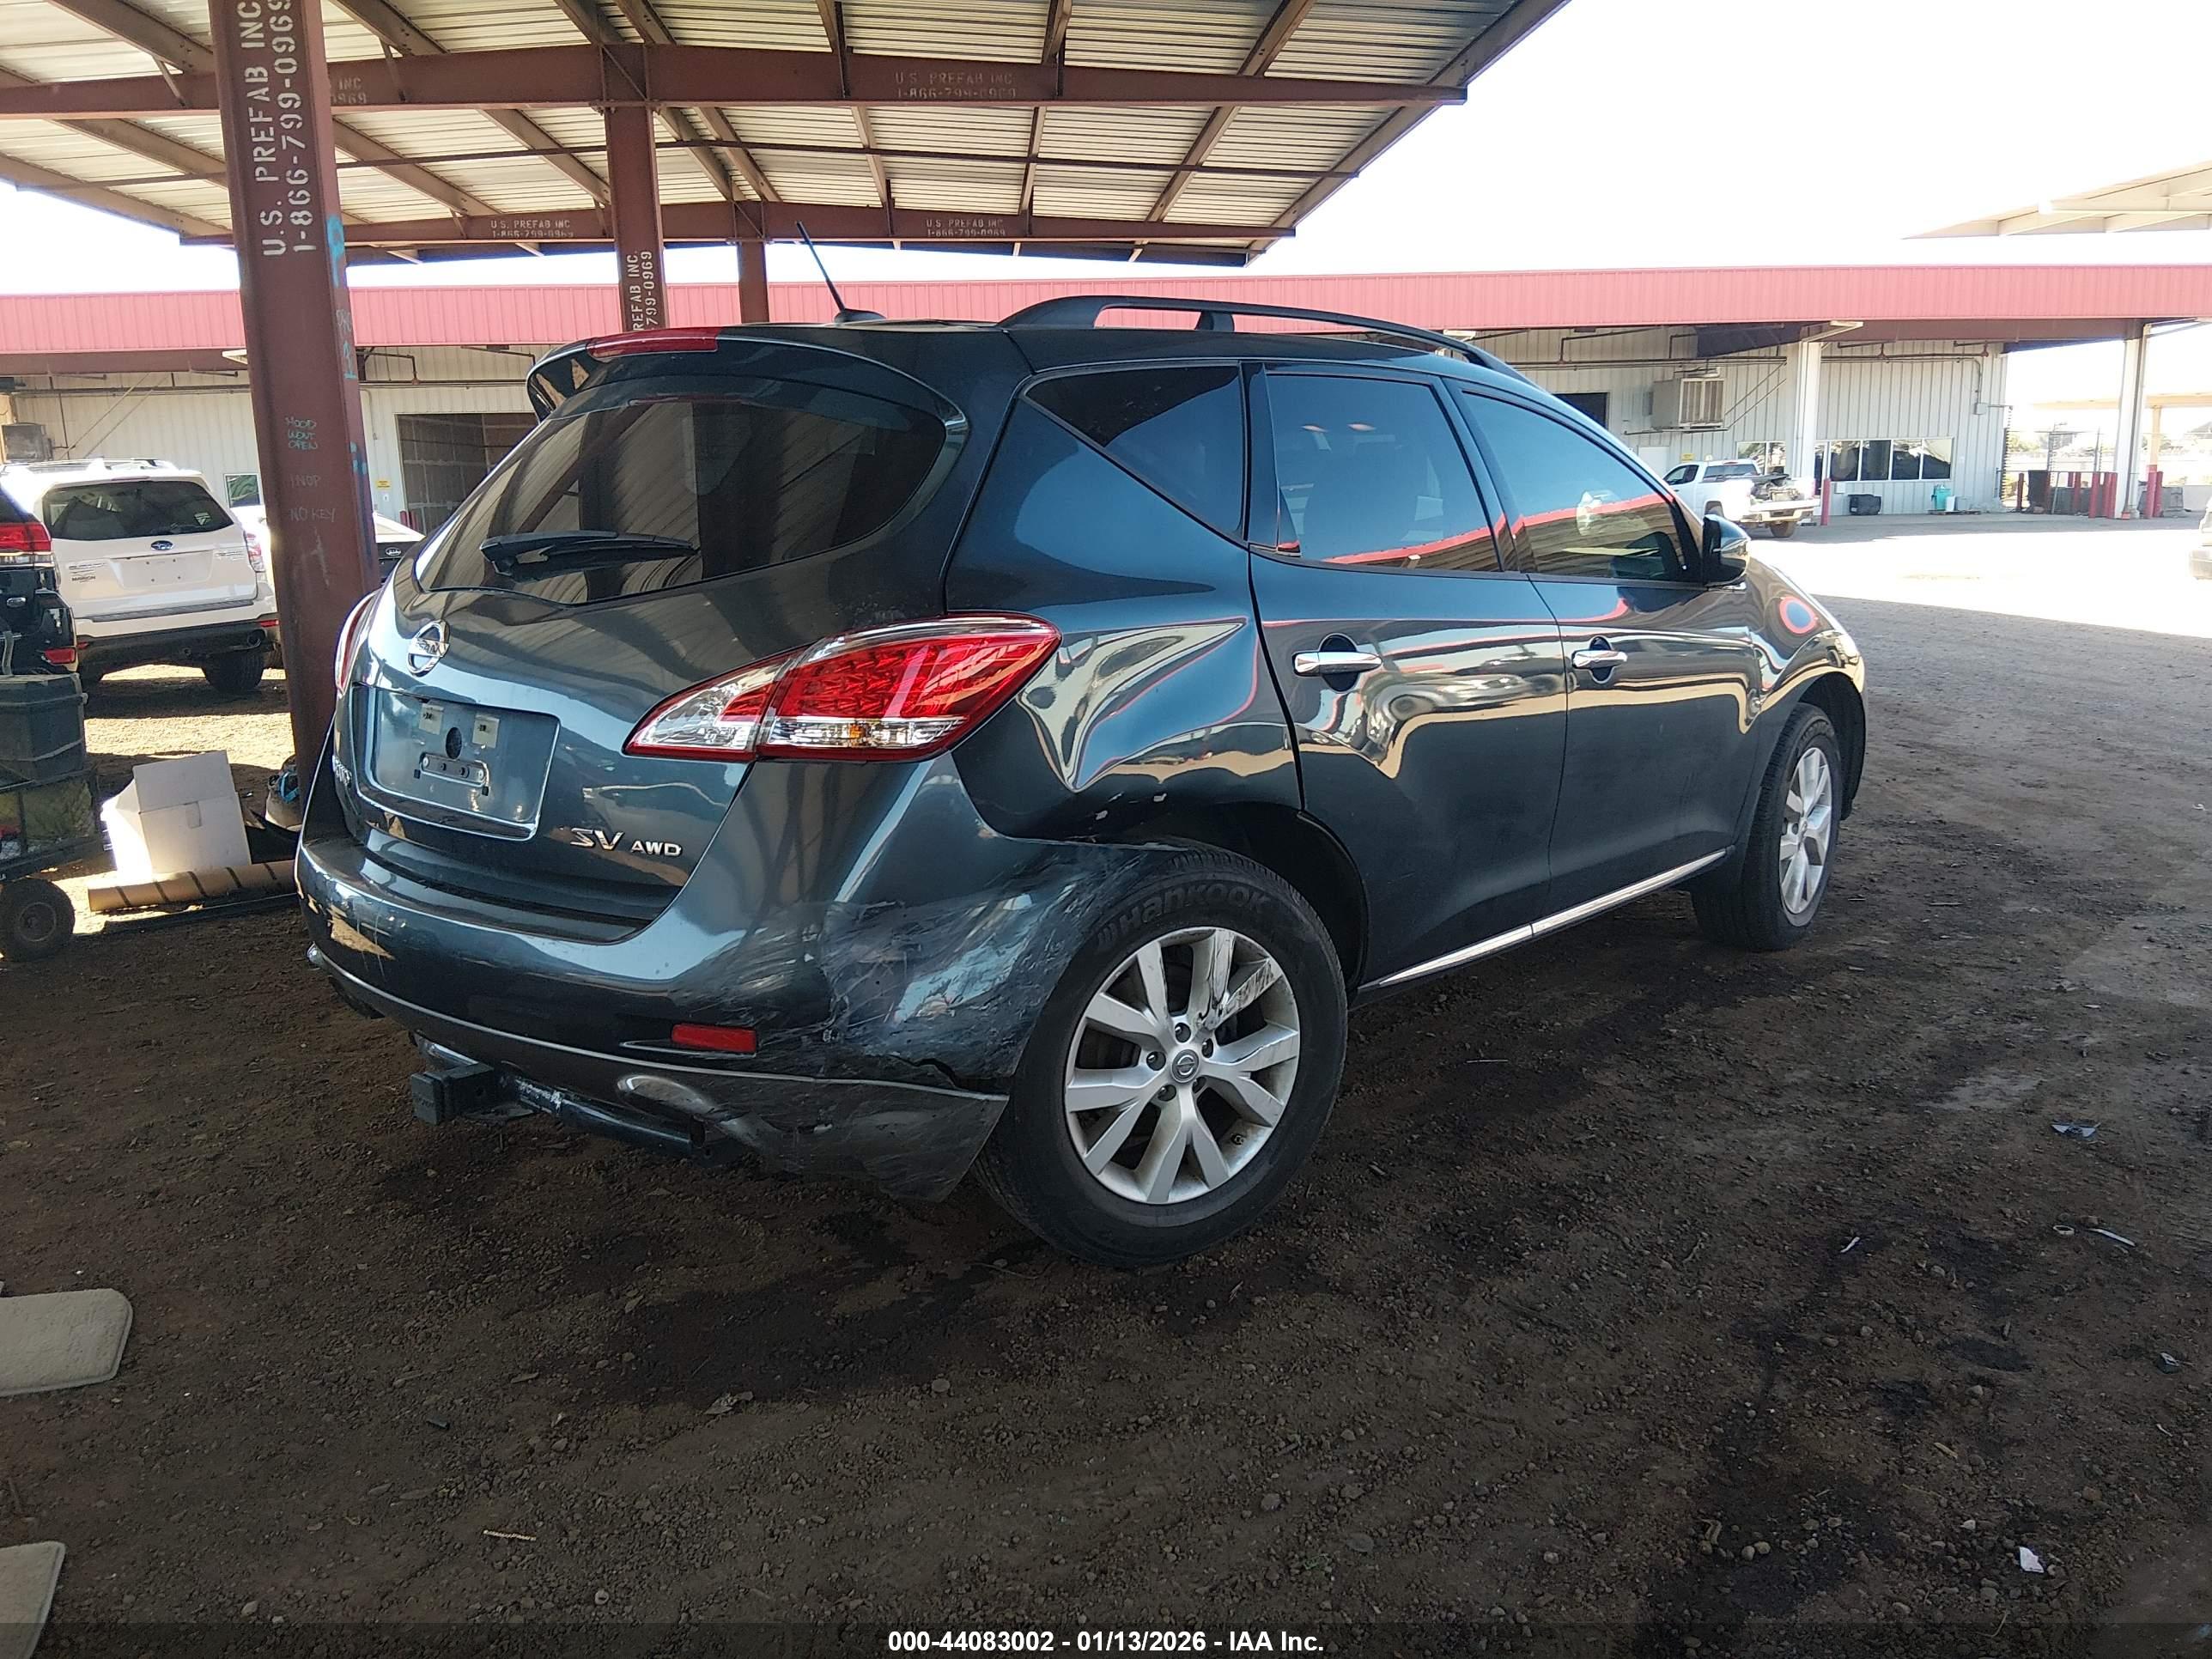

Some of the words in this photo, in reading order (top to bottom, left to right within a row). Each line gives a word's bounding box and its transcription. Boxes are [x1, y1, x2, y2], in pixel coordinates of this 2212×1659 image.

[244, 66, 280, 182] PREFAB
[267, 0, 317, 252] 1-866-799-0969
[260, 200, 286, 256] U.S.
[514, 219, 551, 229] PREFAB
[570, 827, 625, 851] SV
[630, 841, 683, 857] AWD
